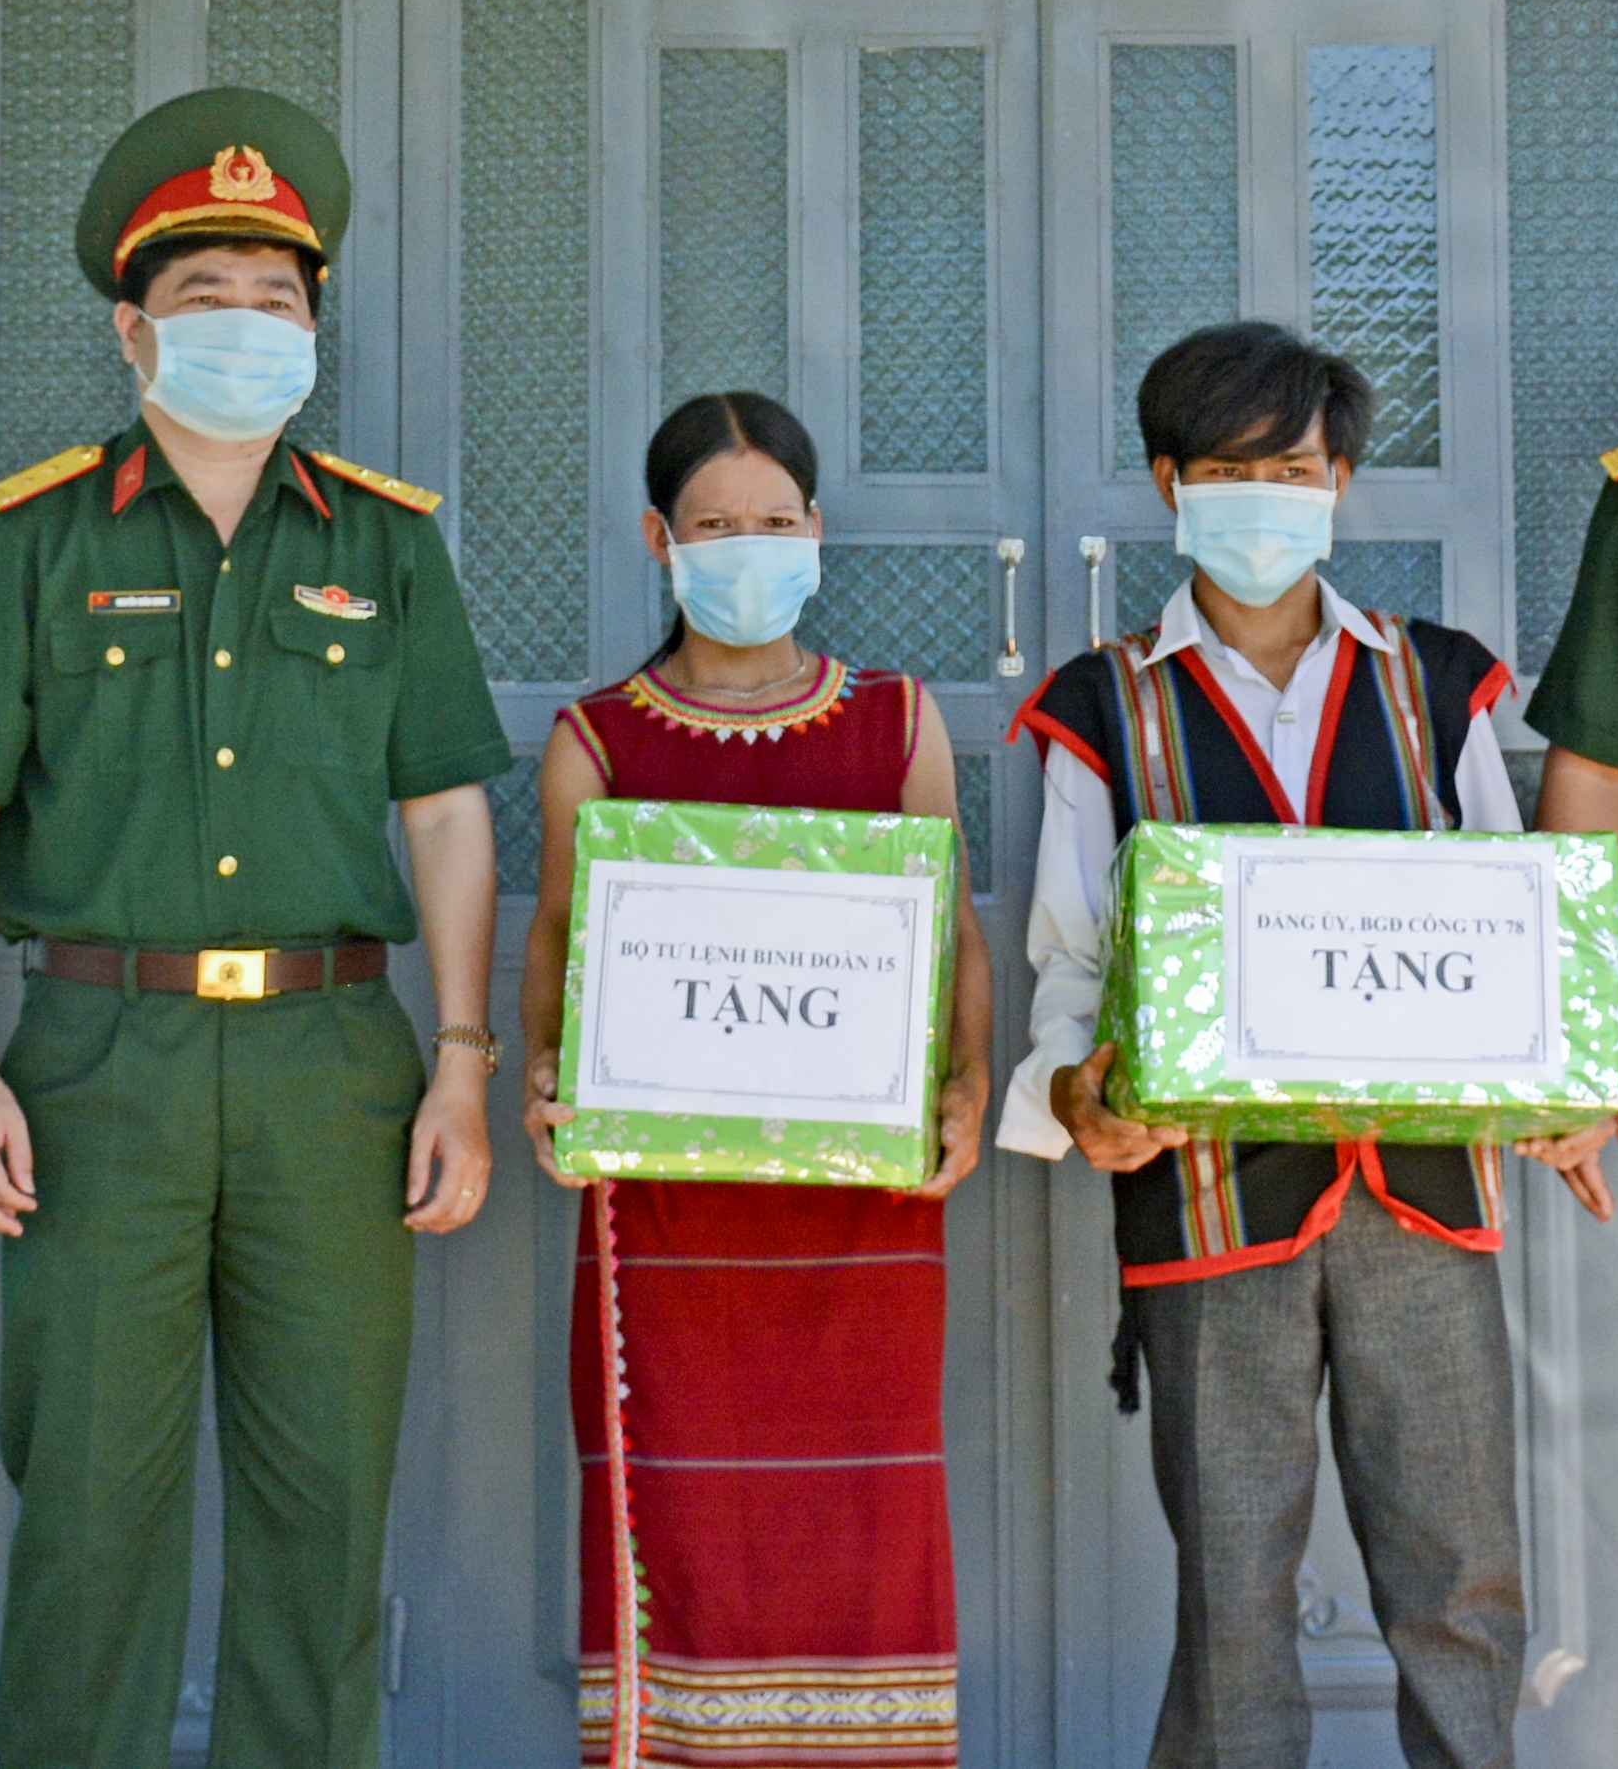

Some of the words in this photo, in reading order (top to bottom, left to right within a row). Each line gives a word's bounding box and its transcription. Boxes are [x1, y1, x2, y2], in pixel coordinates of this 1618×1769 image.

[1408, 913, 1467, 934] CÔNG
[1472, 920, 1500, 935] TY
[1506, 920, 1526, 935] 78
[620, 939, 649, 961] BỘ
[655, 941, 686, 960] TƯ
[690, 943, 746, 966] LỆNH
[753, 949, 803, 967] BINH
[810, 949, 869, 972] ĐOÀN
[877, 957, 896, 972] 15
[1312, 943, 1475, 1002] TẶNG
[674, 975, 840, 1035] TẶNG
